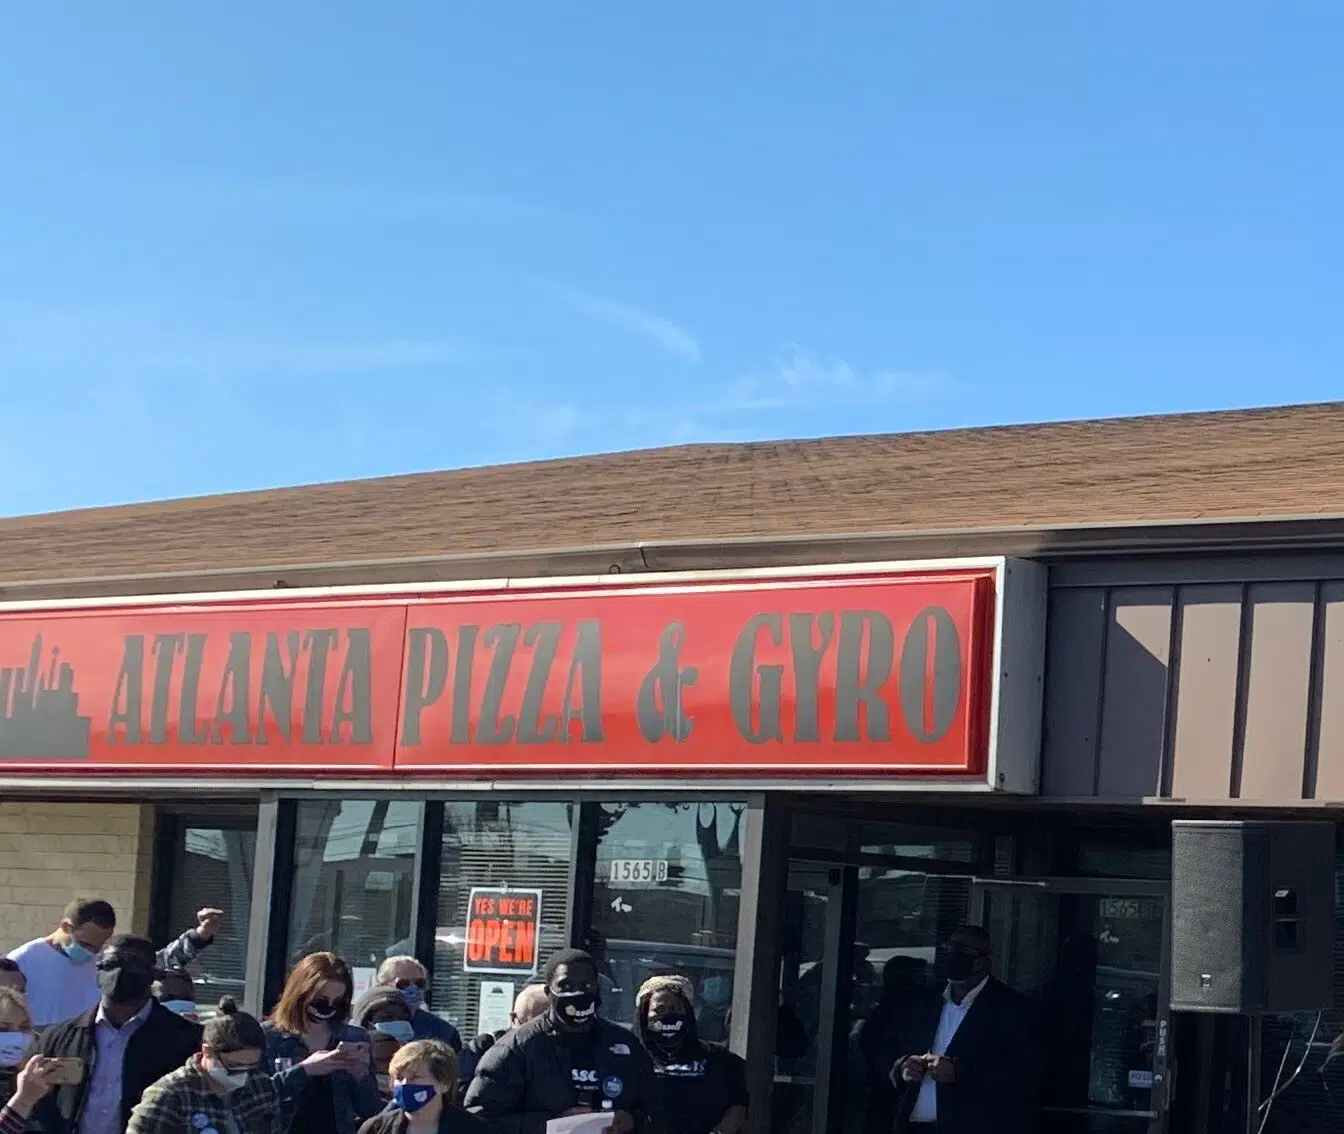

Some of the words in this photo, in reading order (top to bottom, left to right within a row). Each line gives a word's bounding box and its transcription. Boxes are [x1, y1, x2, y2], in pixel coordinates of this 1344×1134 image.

[107, 627, 373, 745] ATLANTA
[399, 619, 606, 746] PIZZA
[636, 621, 698, 744] &
[728, 605, 962, 746] GYRO
[613, 861, 651, 880] 1565
[656, 861, 667, 880] B
[475, 898, 494, 915] YES
[499, 898, 533, 916] WE'RE
[468, 919, 534, 963] OPEN
